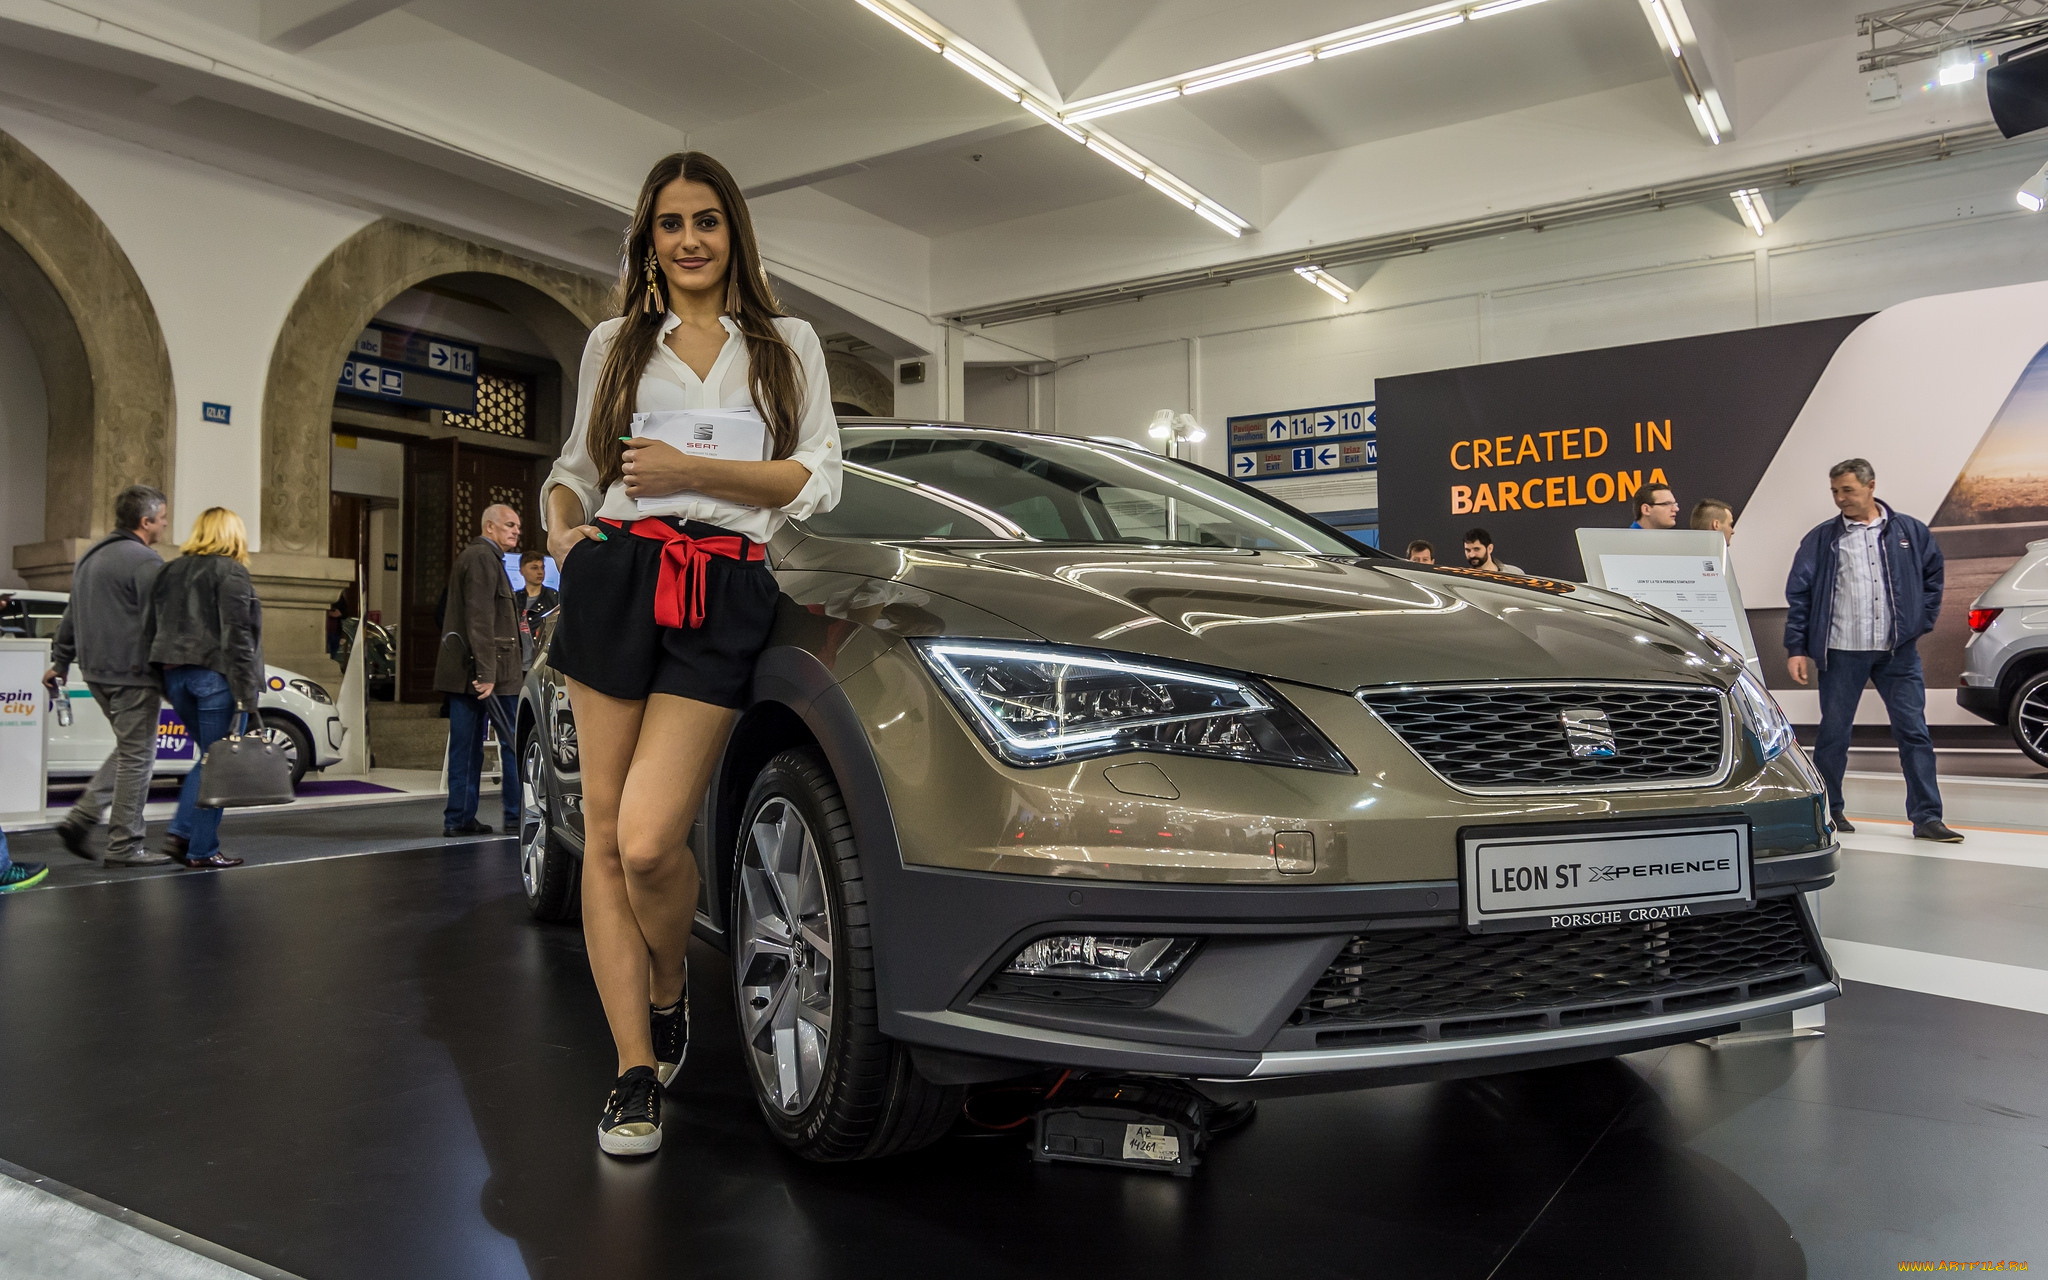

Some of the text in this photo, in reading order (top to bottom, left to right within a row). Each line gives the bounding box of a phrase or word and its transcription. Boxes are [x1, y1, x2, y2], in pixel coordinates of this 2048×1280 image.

[1291, 411, 1361, 436] 11d 10
[686, 442, 718, 450] SEAT
[1450, 419, 1672, 471] CREATED IN
[1265, 462, 1280, 471] Exit
[0, 689, 33, 704] spin
[3, 701, 36, 716] city
[157, 721, 185, 735] pin
[1492, 865, 1548, 893] LEON
[1555, 863, 1582, 889] ST
[1551, 904, 1692, 928] PORSCHE CROATIA
[1129, 1138, 1156, 1153] 14261
